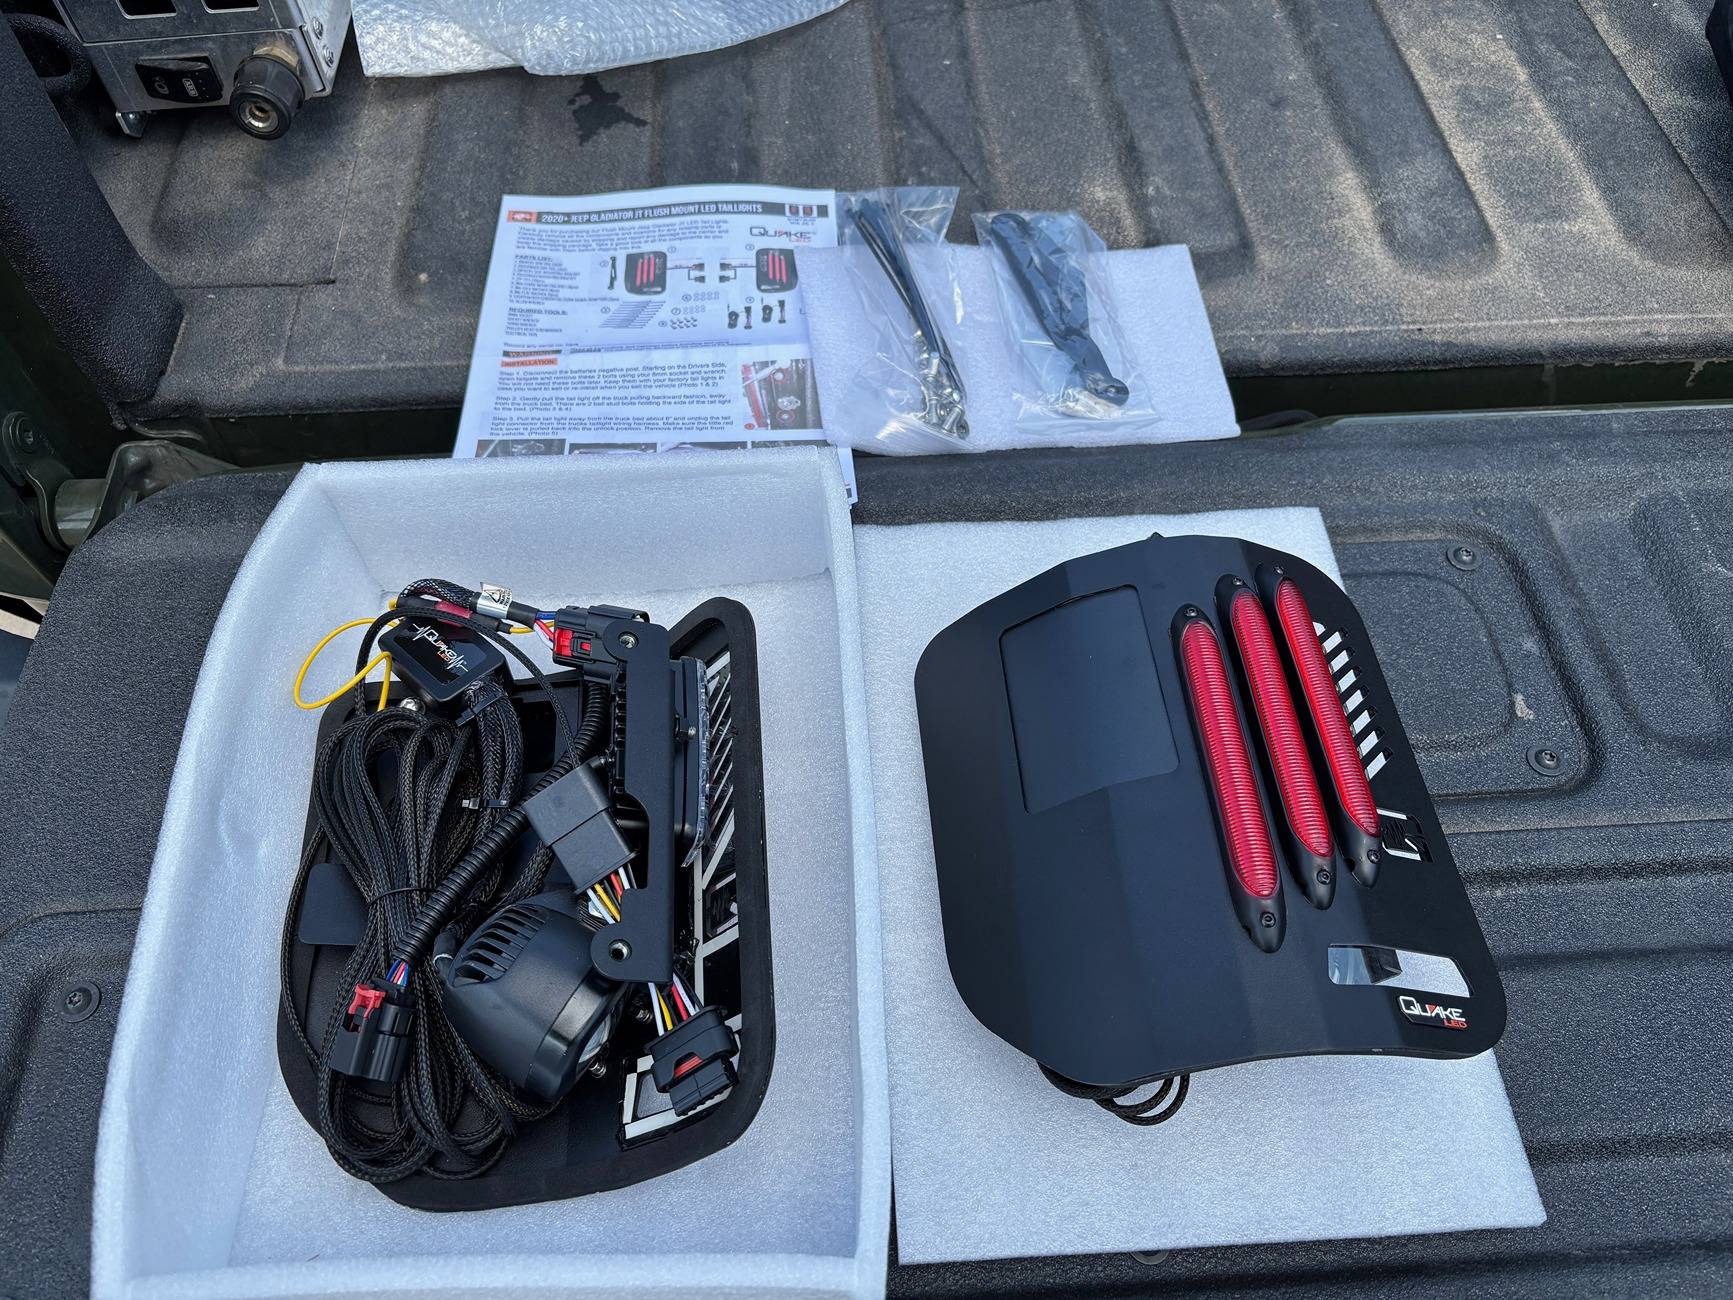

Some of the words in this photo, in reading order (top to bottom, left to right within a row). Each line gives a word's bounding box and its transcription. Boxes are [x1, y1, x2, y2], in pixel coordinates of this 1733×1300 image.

[570, 214, 589, 222] JEEP
[590, 211, 633, 222] GLADIATOR
[644, 207, 670, 218] FLUSH
[670, 204, 698, 214] MOUNT
[700, 204, 716, 212] LED
[718, 204, 762, 213] TAILLIGHTS
[750, 227, 810, 238] QUAKE
[425, 629, 457, 658] QUAKE
[1399, 995, 1466, 1021] QUAKE
[1443, 1019, 1468, 1029] LED
